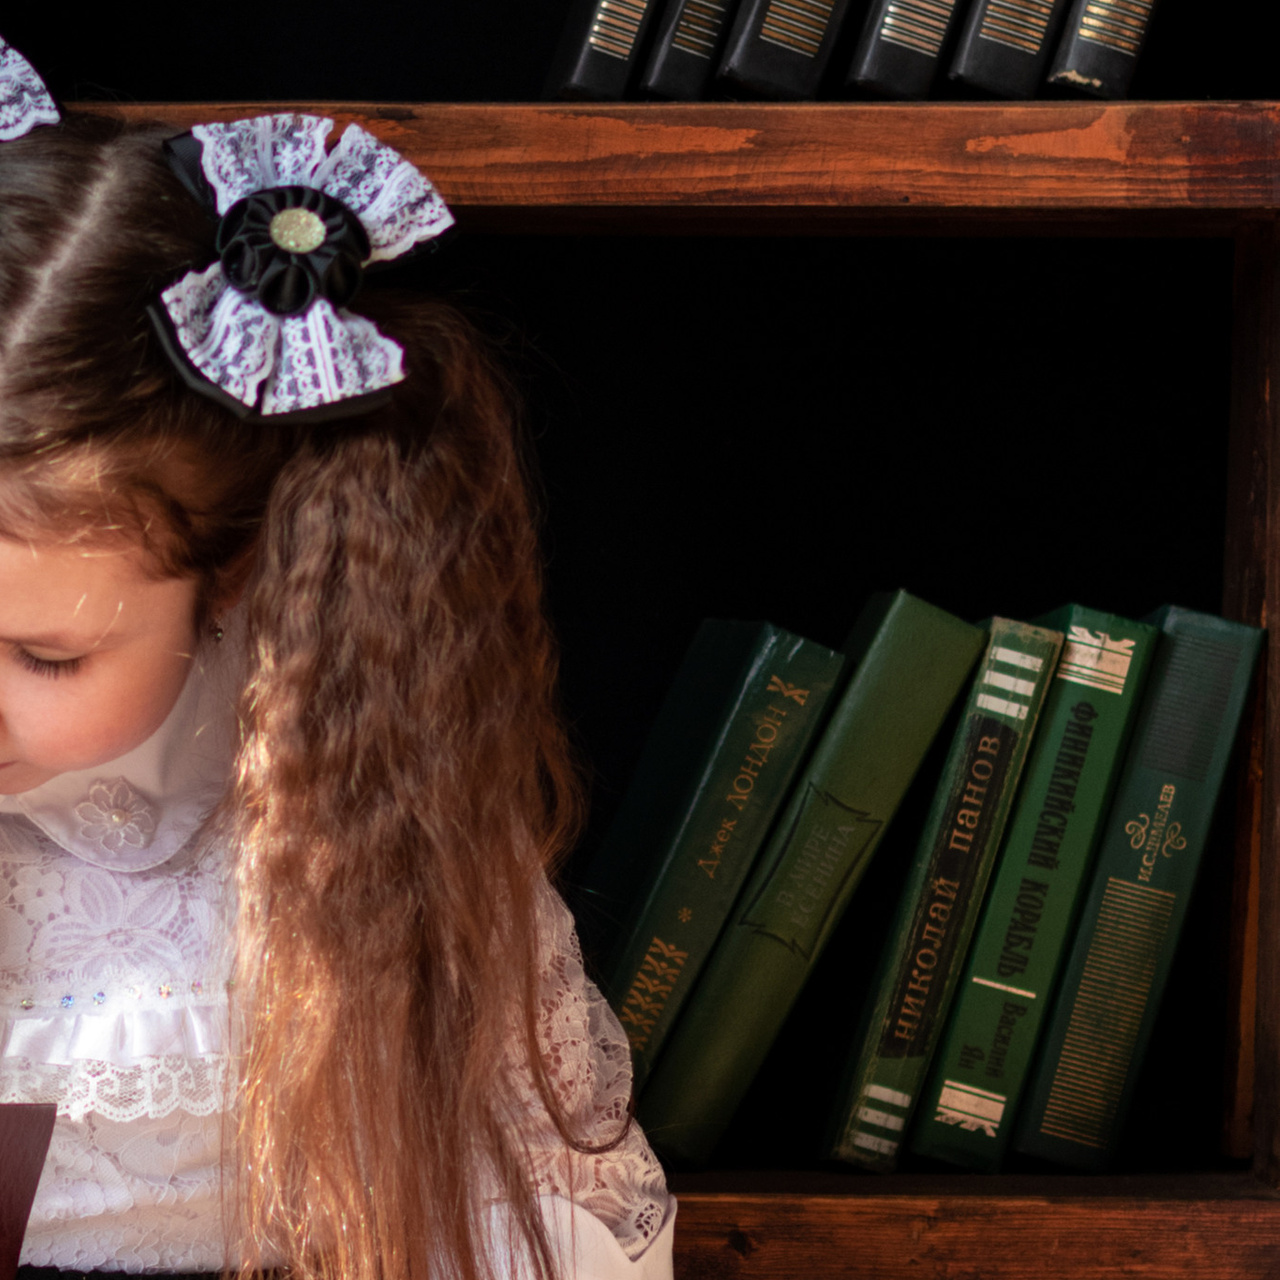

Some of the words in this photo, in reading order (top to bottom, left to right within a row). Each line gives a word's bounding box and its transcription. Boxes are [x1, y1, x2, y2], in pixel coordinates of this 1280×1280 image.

[698, 817, 737, 879] Джек
[726, 705, 787, 812] ЛОНДОН
[1028, 701, 1099, 870] ФИНИКИЙСКИЙ
[790, 824, 833, 882] МИРЕ
[793, 823, 857, 929] ЕСЕНИНА
[997, 876, 1049, 978] КОРАБЛЬ
[958, 1044, 984, 1070] Ян
[986, 1000, 1026, 1078] Василий
